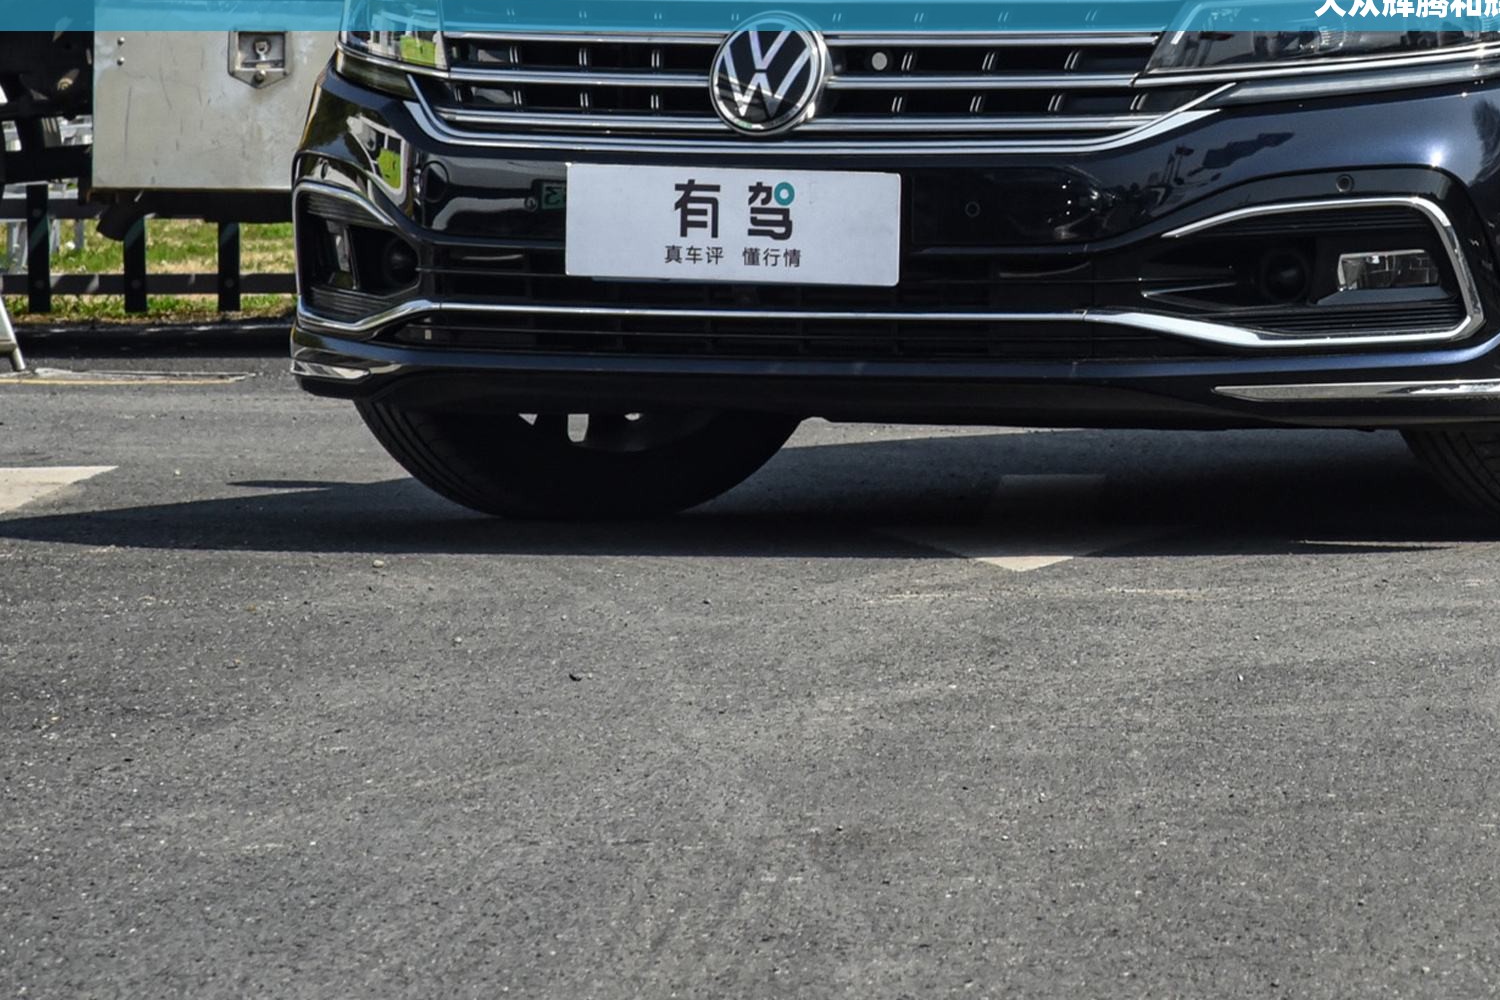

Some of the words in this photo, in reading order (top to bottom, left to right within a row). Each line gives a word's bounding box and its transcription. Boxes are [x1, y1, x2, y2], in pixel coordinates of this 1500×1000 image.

[664, 244, 725, 265] 真车评
[742, 246, 802, 268] 懂行情
